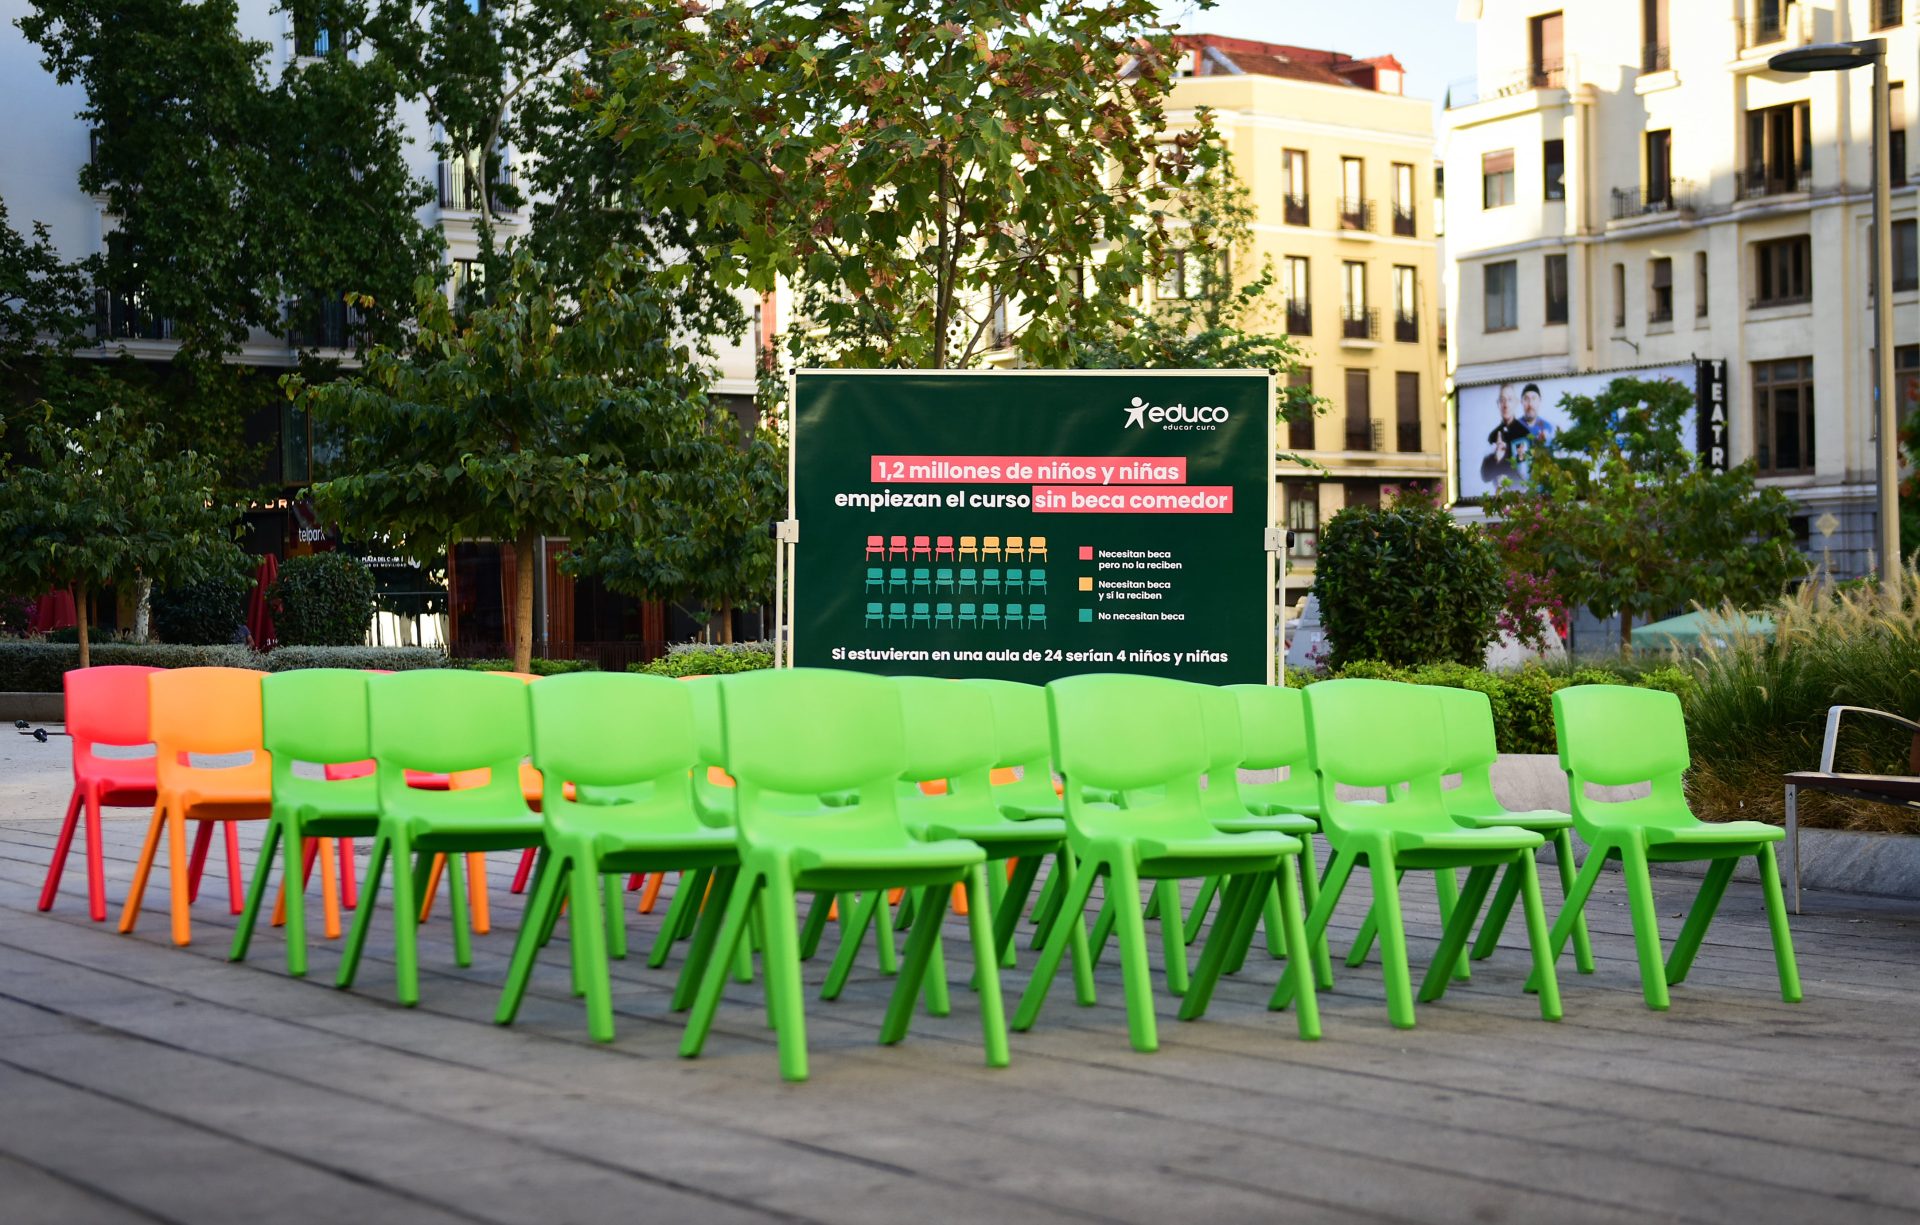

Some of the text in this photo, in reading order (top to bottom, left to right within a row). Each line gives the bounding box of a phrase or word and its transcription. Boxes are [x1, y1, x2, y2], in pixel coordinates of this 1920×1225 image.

[1148, 403, 1229, 423] educo
[878, 460, 1180, 485] 1,2 millones de niños y niñas
[834, 489, 1228, 513] empiezan el curso sin beca comedor
[1098, 549, 1171, 559] Necesitan beca
[1099, 562, 1120, 571] pero
[1136, 561, 1145, 569] la
[1146, 561, 1182, 570] reciben
[1098, 580, 1171, 589] Necesitan beca
[1098, 591, 1162, 601] y sí la reciben
[1098, 612, 1185, 621] No necesitan beca
[832, 647, 1229, 666] Si estuvieran en una aula de 24 serían 4 niños y niñas
